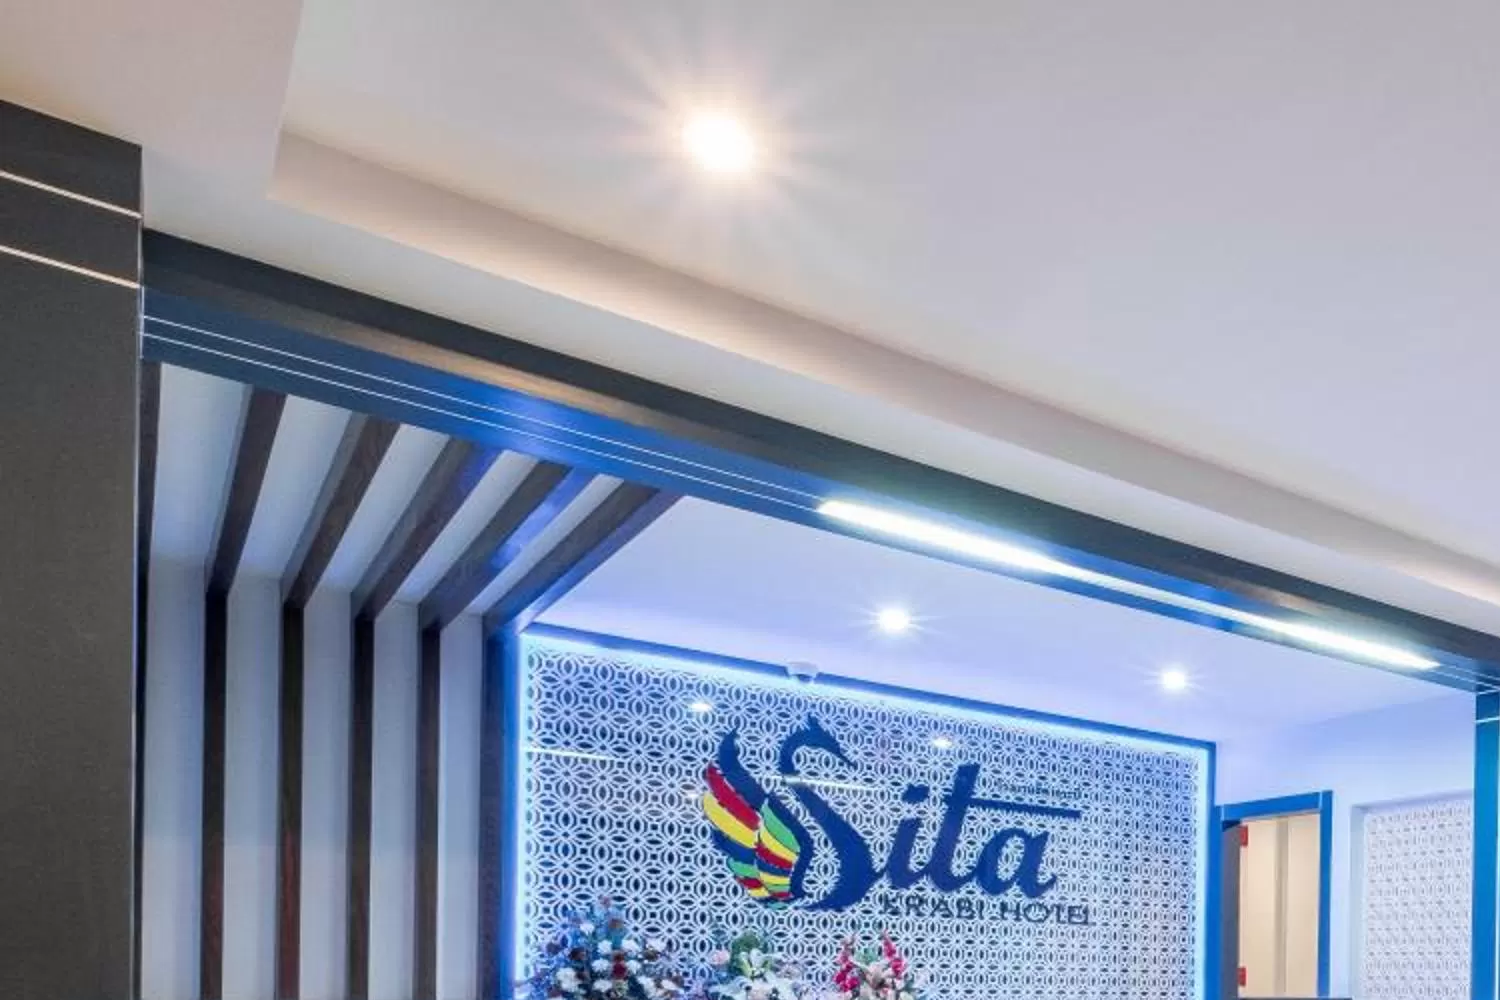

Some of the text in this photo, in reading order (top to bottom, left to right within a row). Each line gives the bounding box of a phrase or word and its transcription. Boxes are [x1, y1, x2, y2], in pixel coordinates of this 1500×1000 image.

[774, 715, 1082, 912] Sita
[882, 894, 1095, 926] KRABI HOTEL
